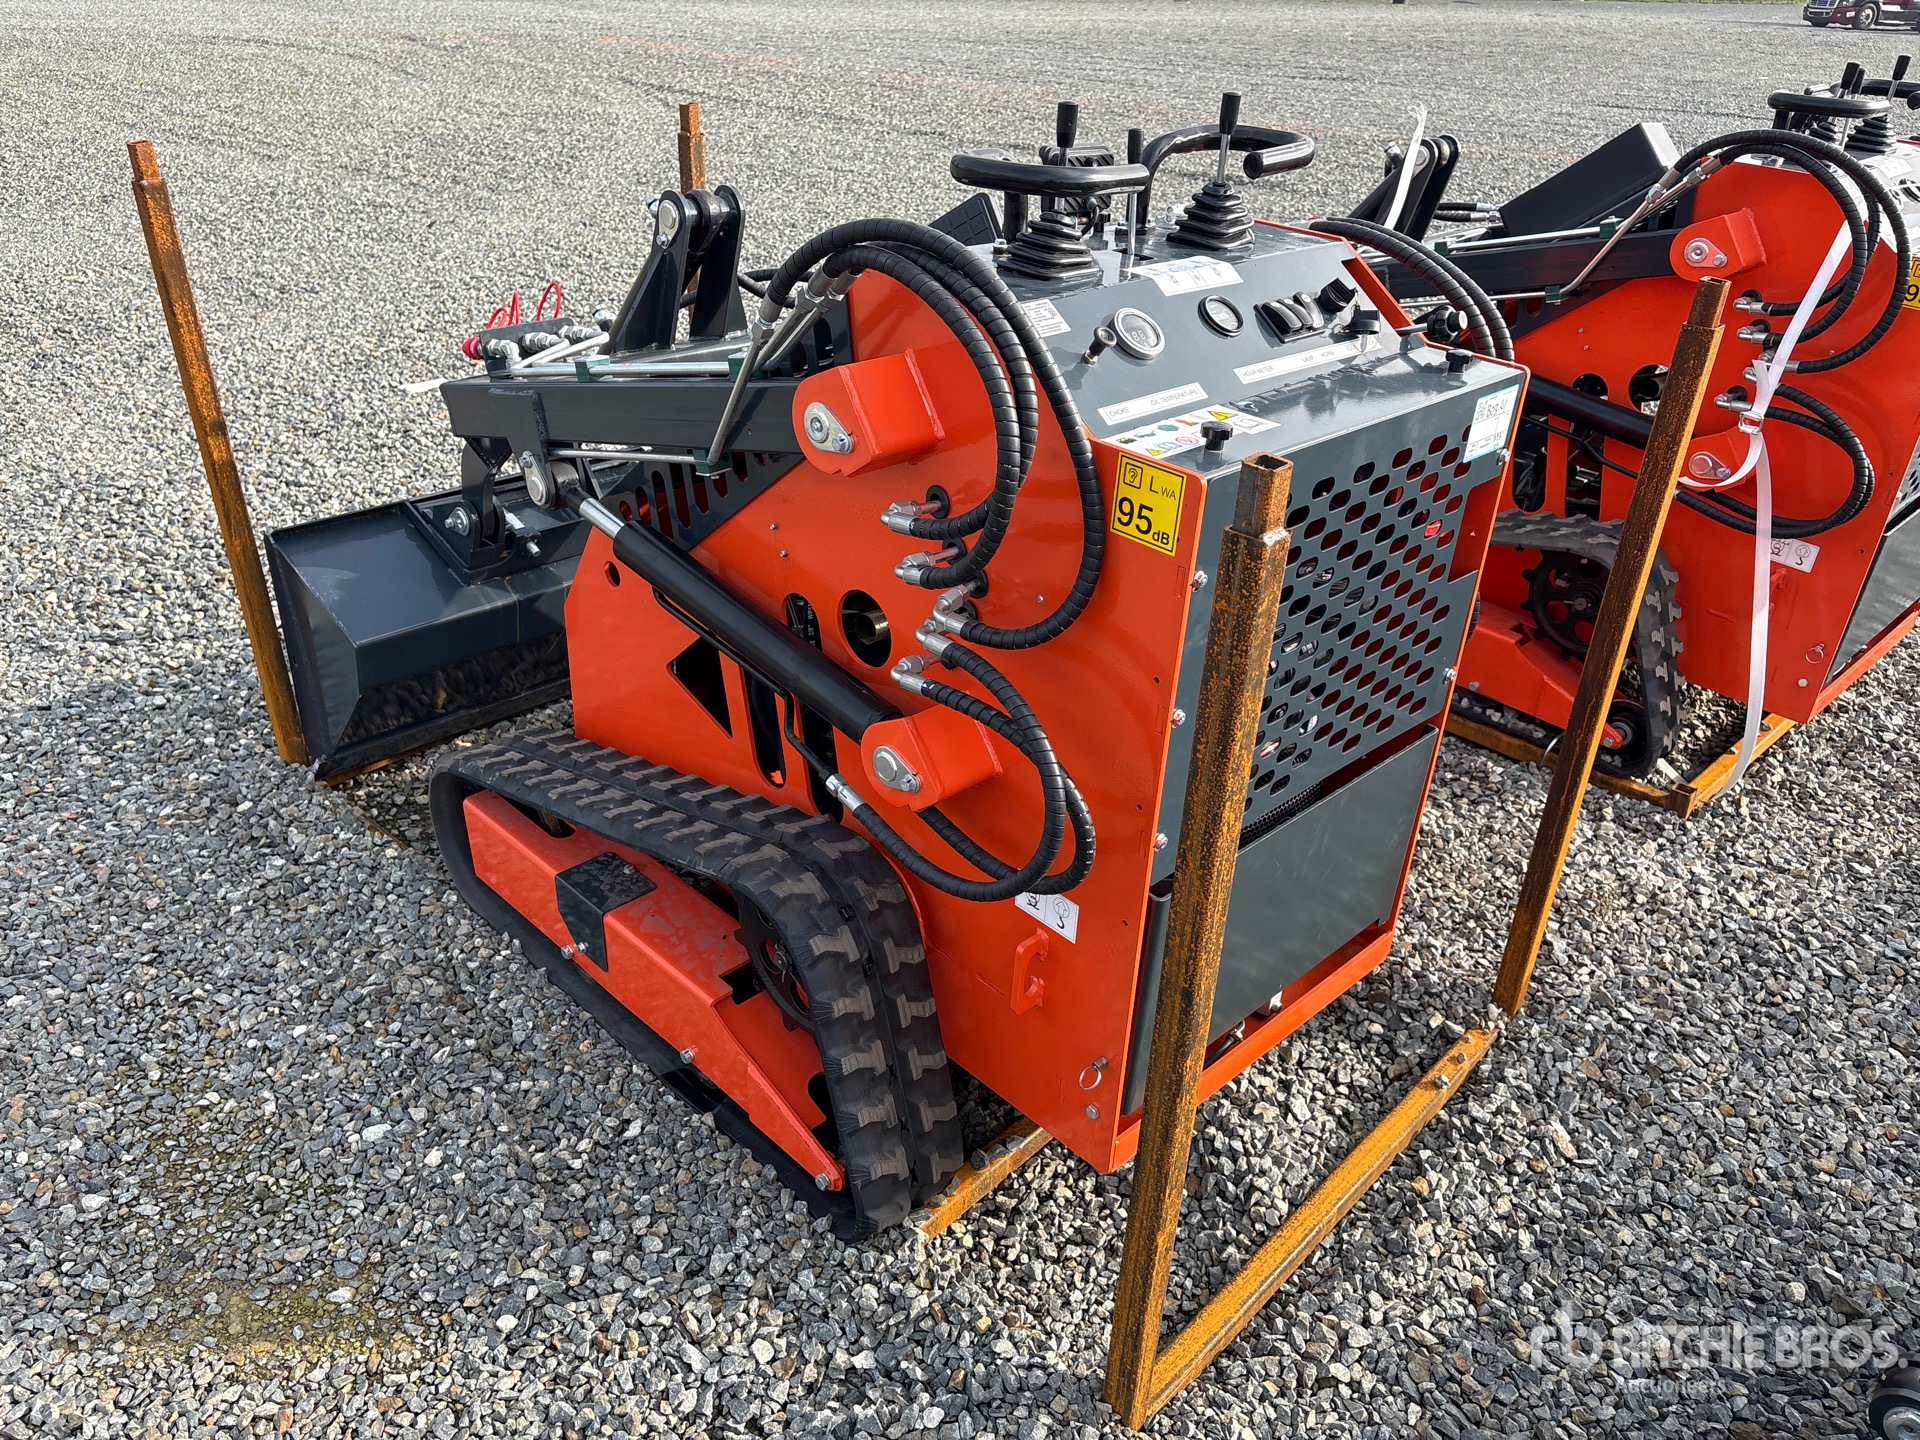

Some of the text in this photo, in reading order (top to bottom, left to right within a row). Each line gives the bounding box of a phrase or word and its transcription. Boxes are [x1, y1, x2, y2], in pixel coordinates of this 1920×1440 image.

[1242, 369, 1257, 378] HOUR
[1256, 365, 1274, 375] METER
[1319, 350, 1335, 358] HORN
[1108, 406, 1130, 417] CHOKE
[1160, 388, 1199, 404] TEMPERATURE
